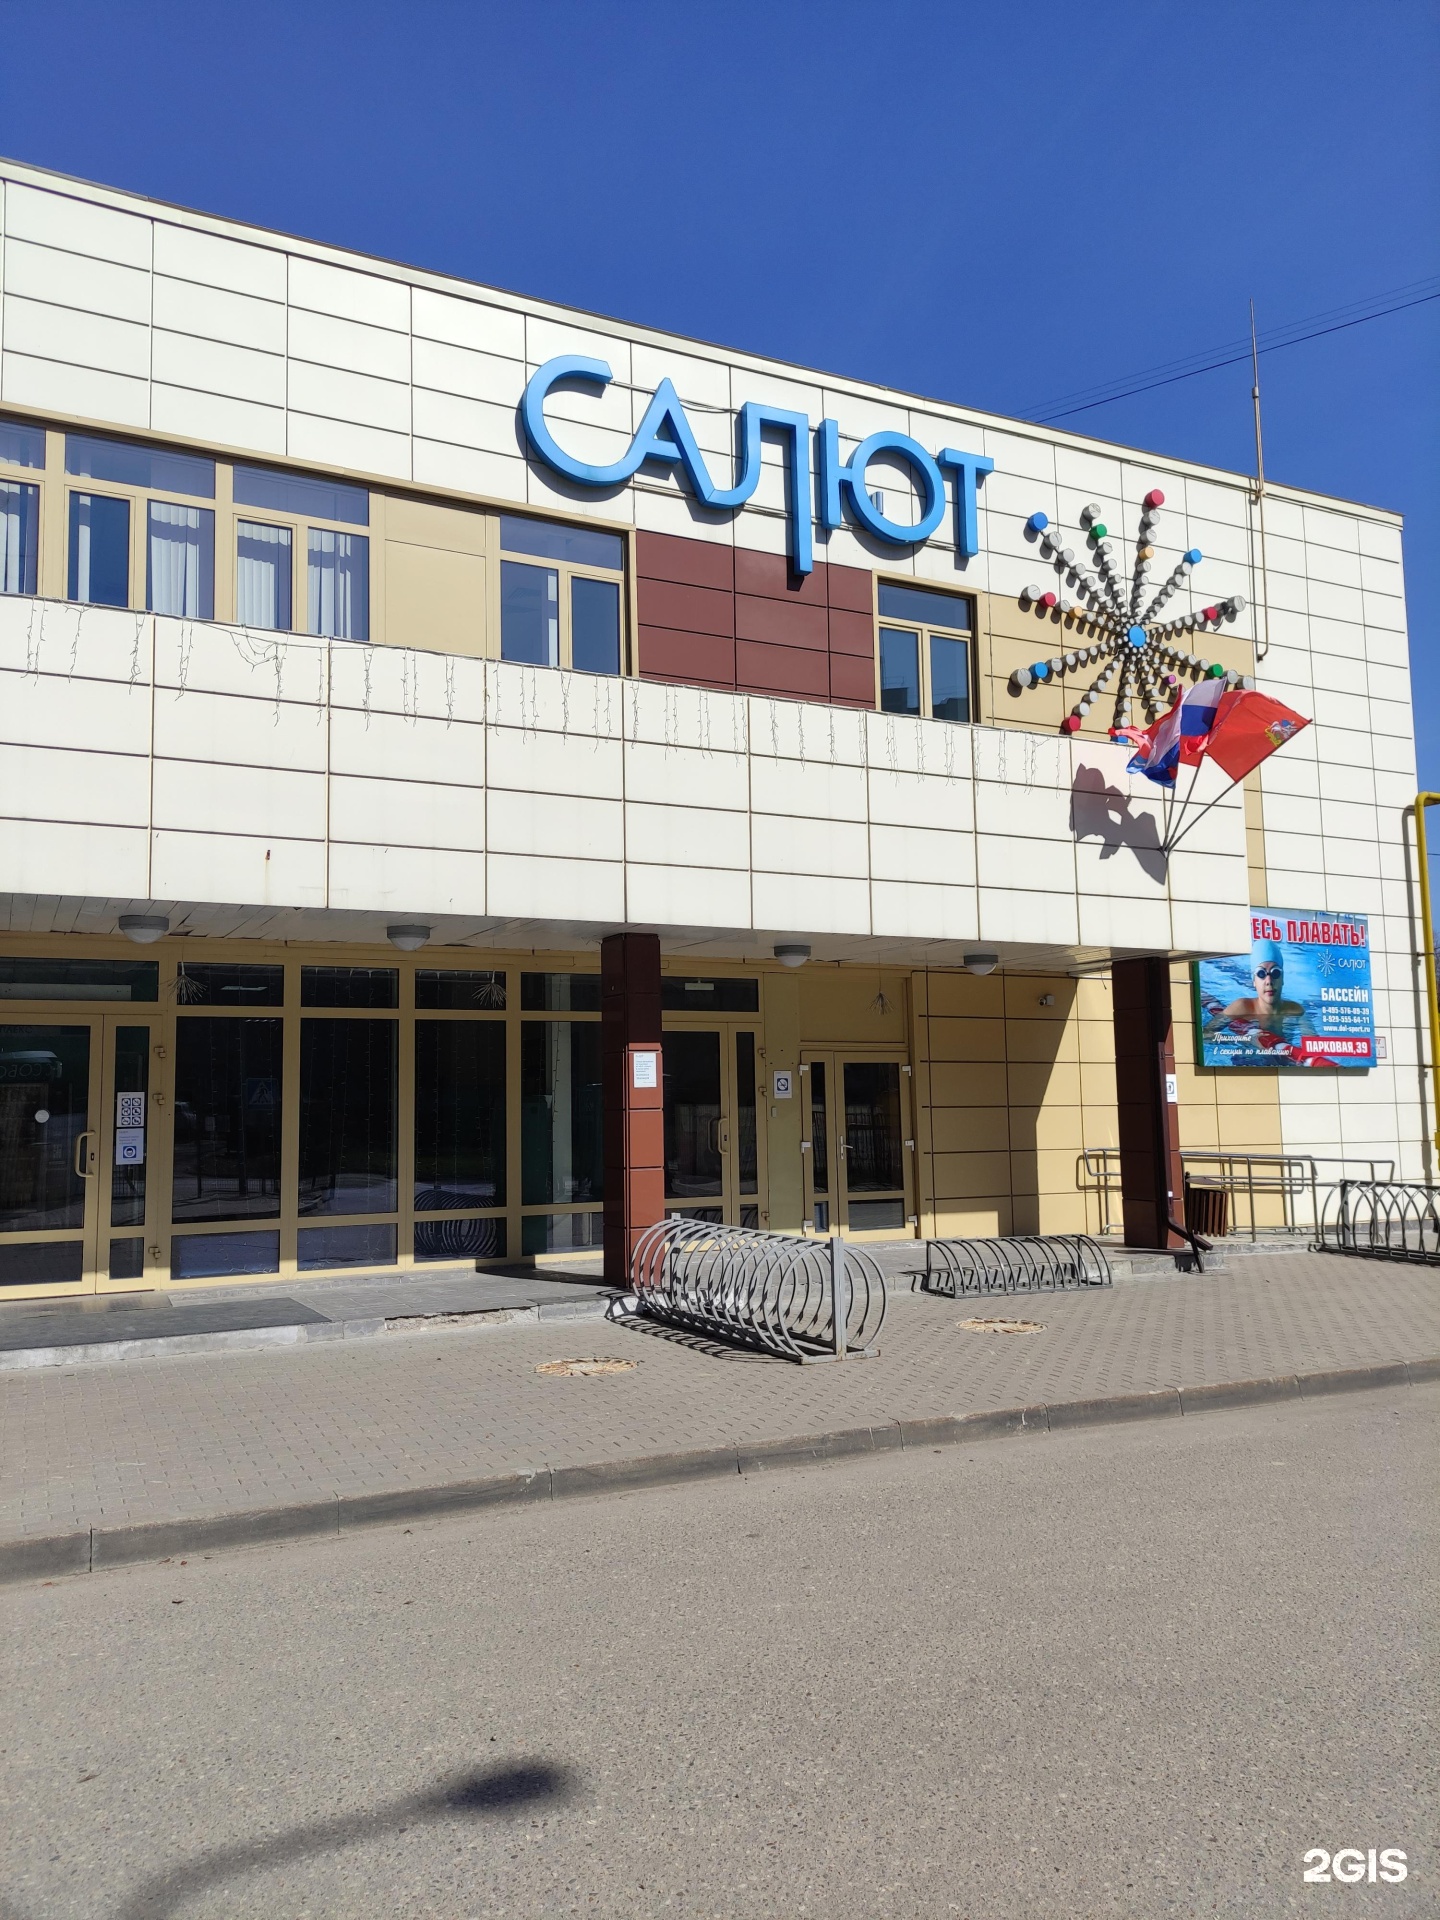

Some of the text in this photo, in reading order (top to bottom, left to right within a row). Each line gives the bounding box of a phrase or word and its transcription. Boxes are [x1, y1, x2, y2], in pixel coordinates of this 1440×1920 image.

[523, 354, 994, 576] САЛЮТ
[1250, 918, 1366, 947] ЕСЬ ПЛАВАТЬ!
[1338, 957, 1367, 972] САЛЮТ
[1320, 986, 1369, 1002] БАССЕЙН
[1212, 1032, 1252, 1044] Приходите
[1219, 1049, 1243, 1057] секции
[1255, 1046, 1293, 1056] плаванию!
[1305, 1041, 1368, 1055] ПАРКОВАЯ,39
